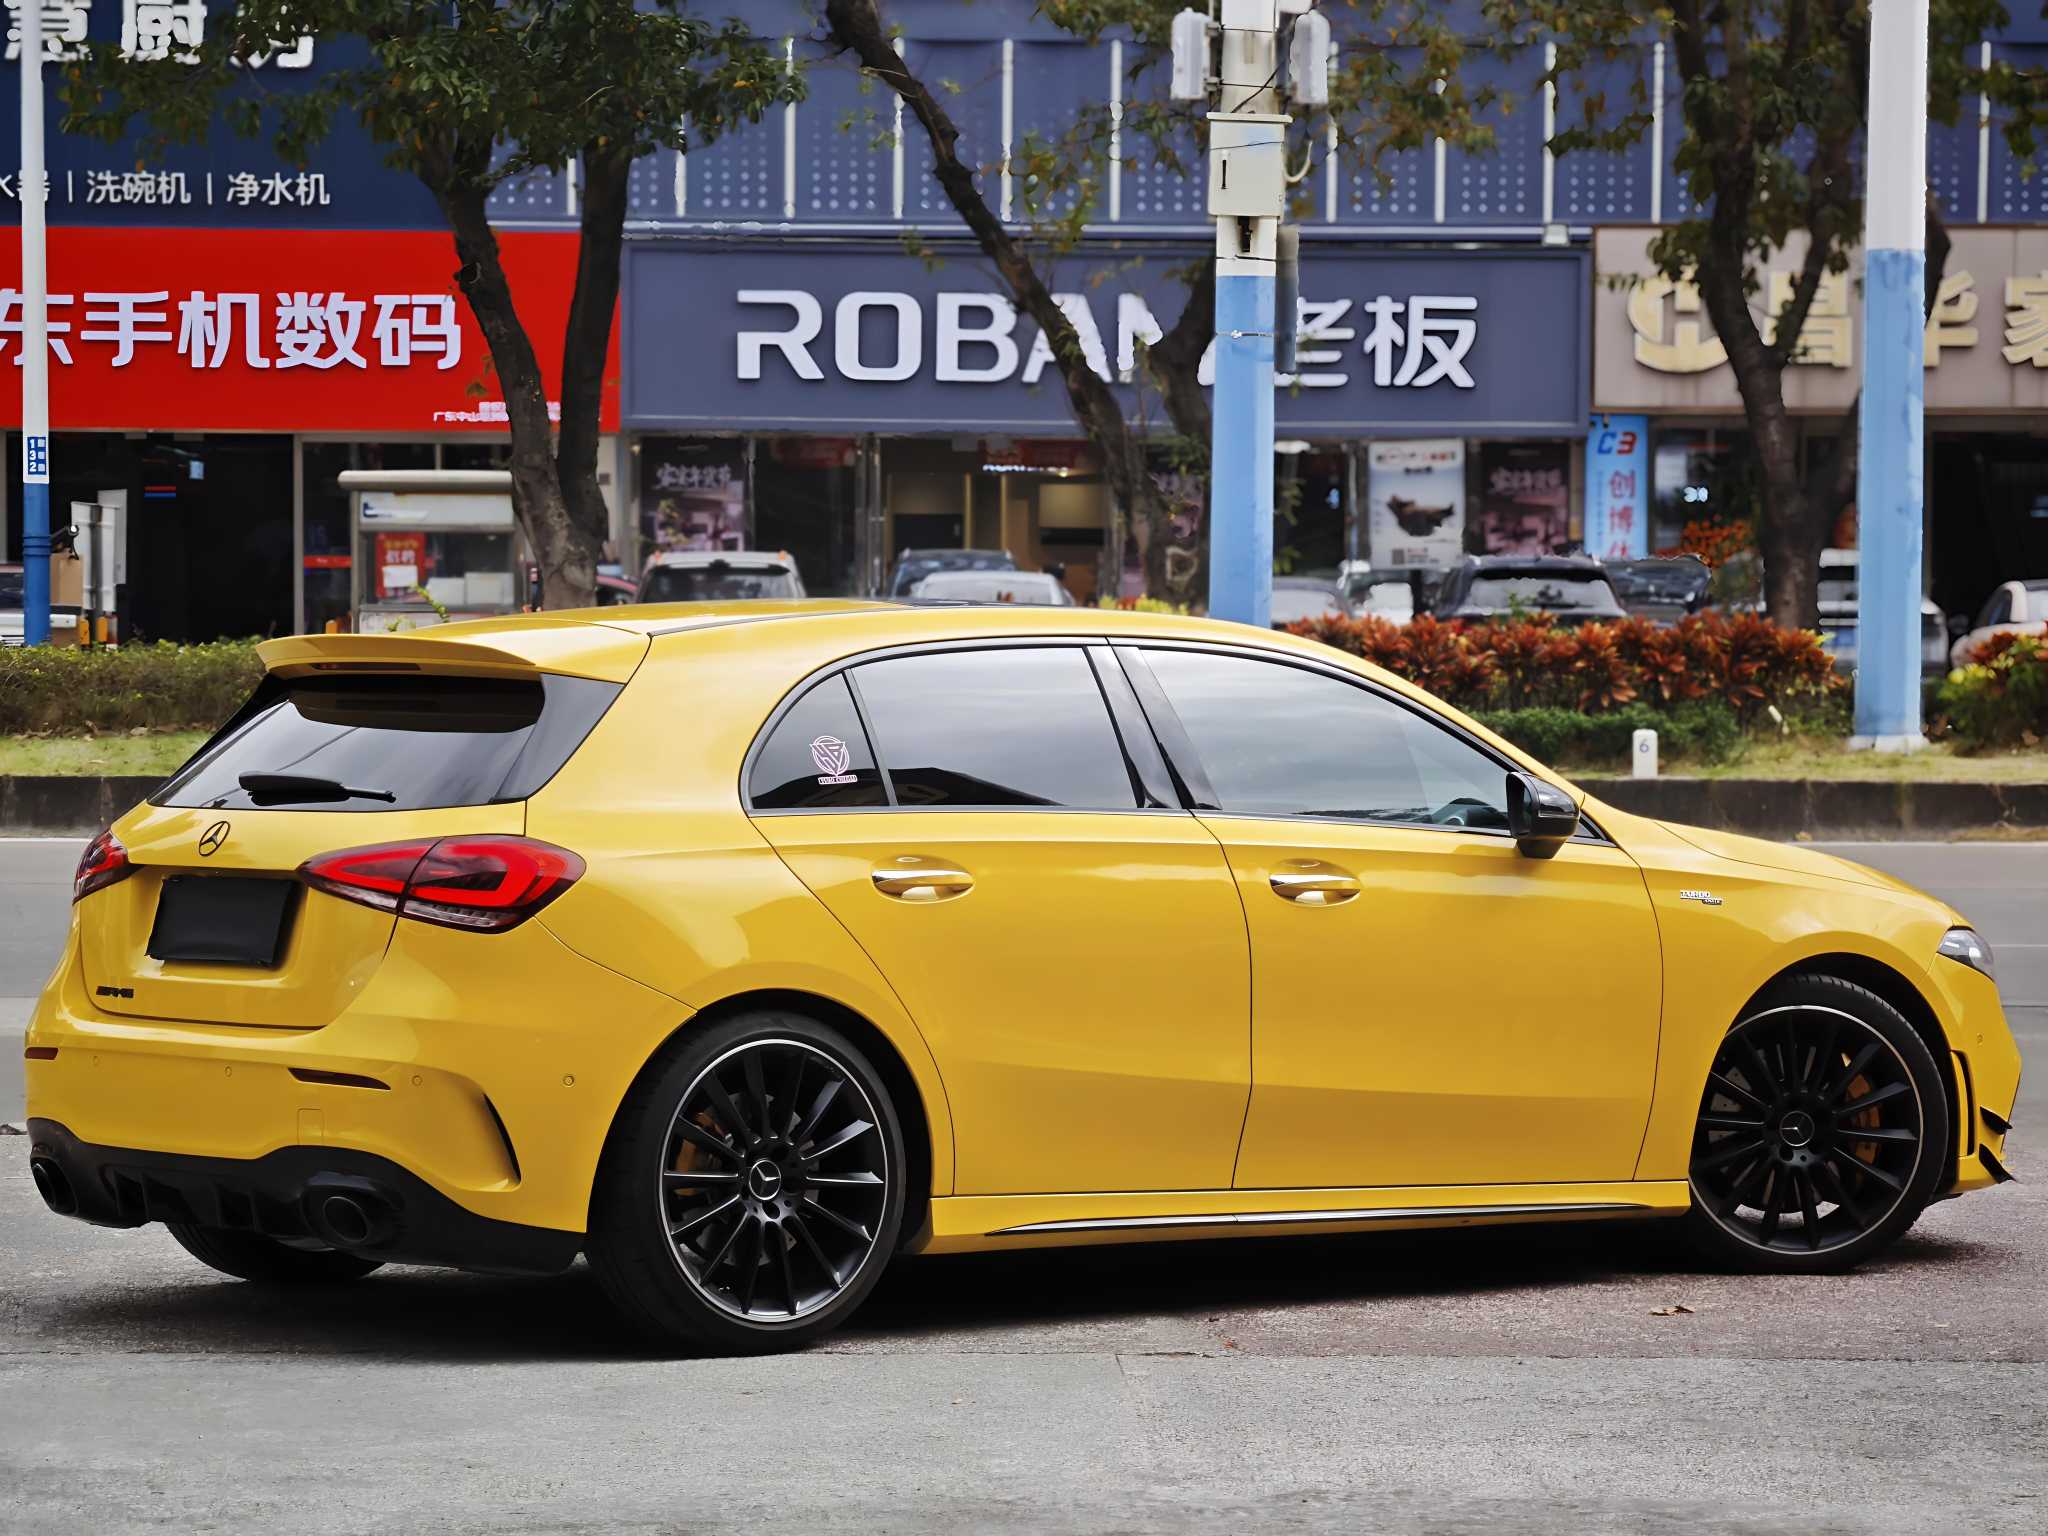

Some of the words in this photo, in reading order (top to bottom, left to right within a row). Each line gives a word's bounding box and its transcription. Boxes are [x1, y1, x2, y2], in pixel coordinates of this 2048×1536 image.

[86, 170, 191, 204] 洗碗机
[226, 171, 330, 206] 净水机
